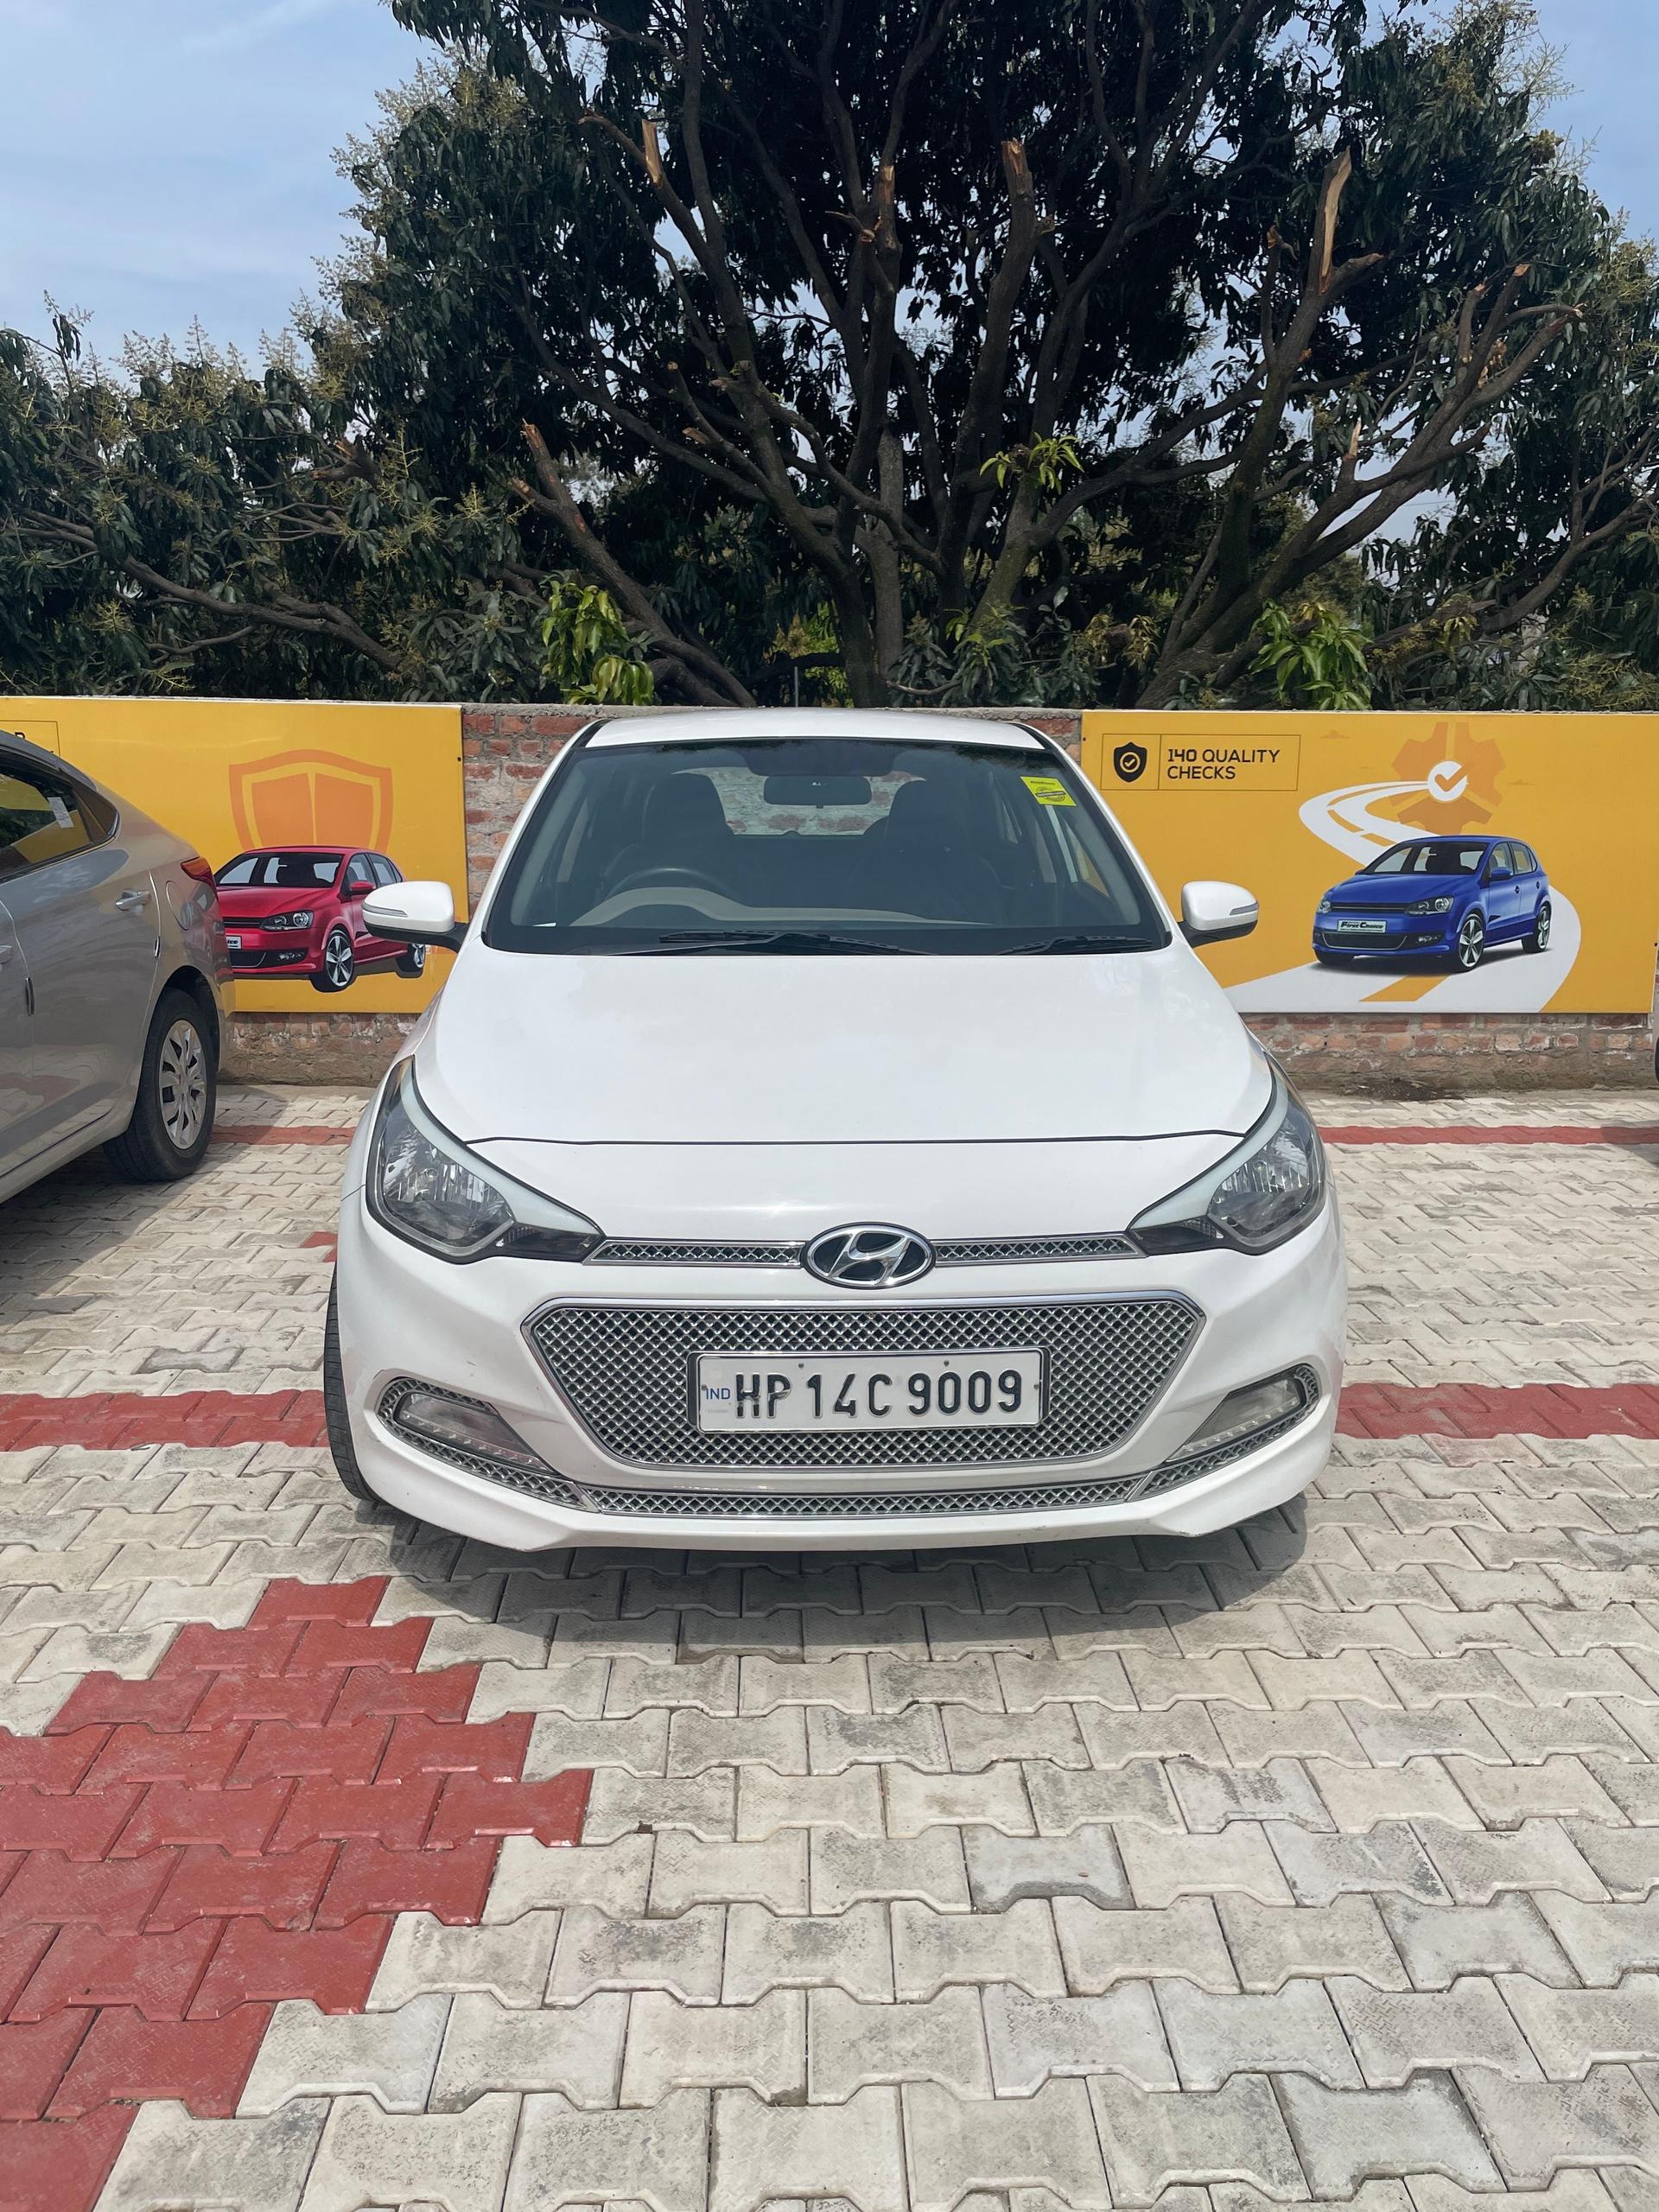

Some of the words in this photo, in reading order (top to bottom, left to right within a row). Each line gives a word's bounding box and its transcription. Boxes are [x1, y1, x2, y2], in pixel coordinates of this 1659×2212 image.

[1167, 748, 1197, 763] 140
[1202, 749, 1281, 763] QUALITY
[1167, 766, 1236, 779] CHECKS
[705, 1388, 731, 1401] IND
[734, 1372, 792, 1419] HP
[906, 1369, 1023, 1417] 9009
